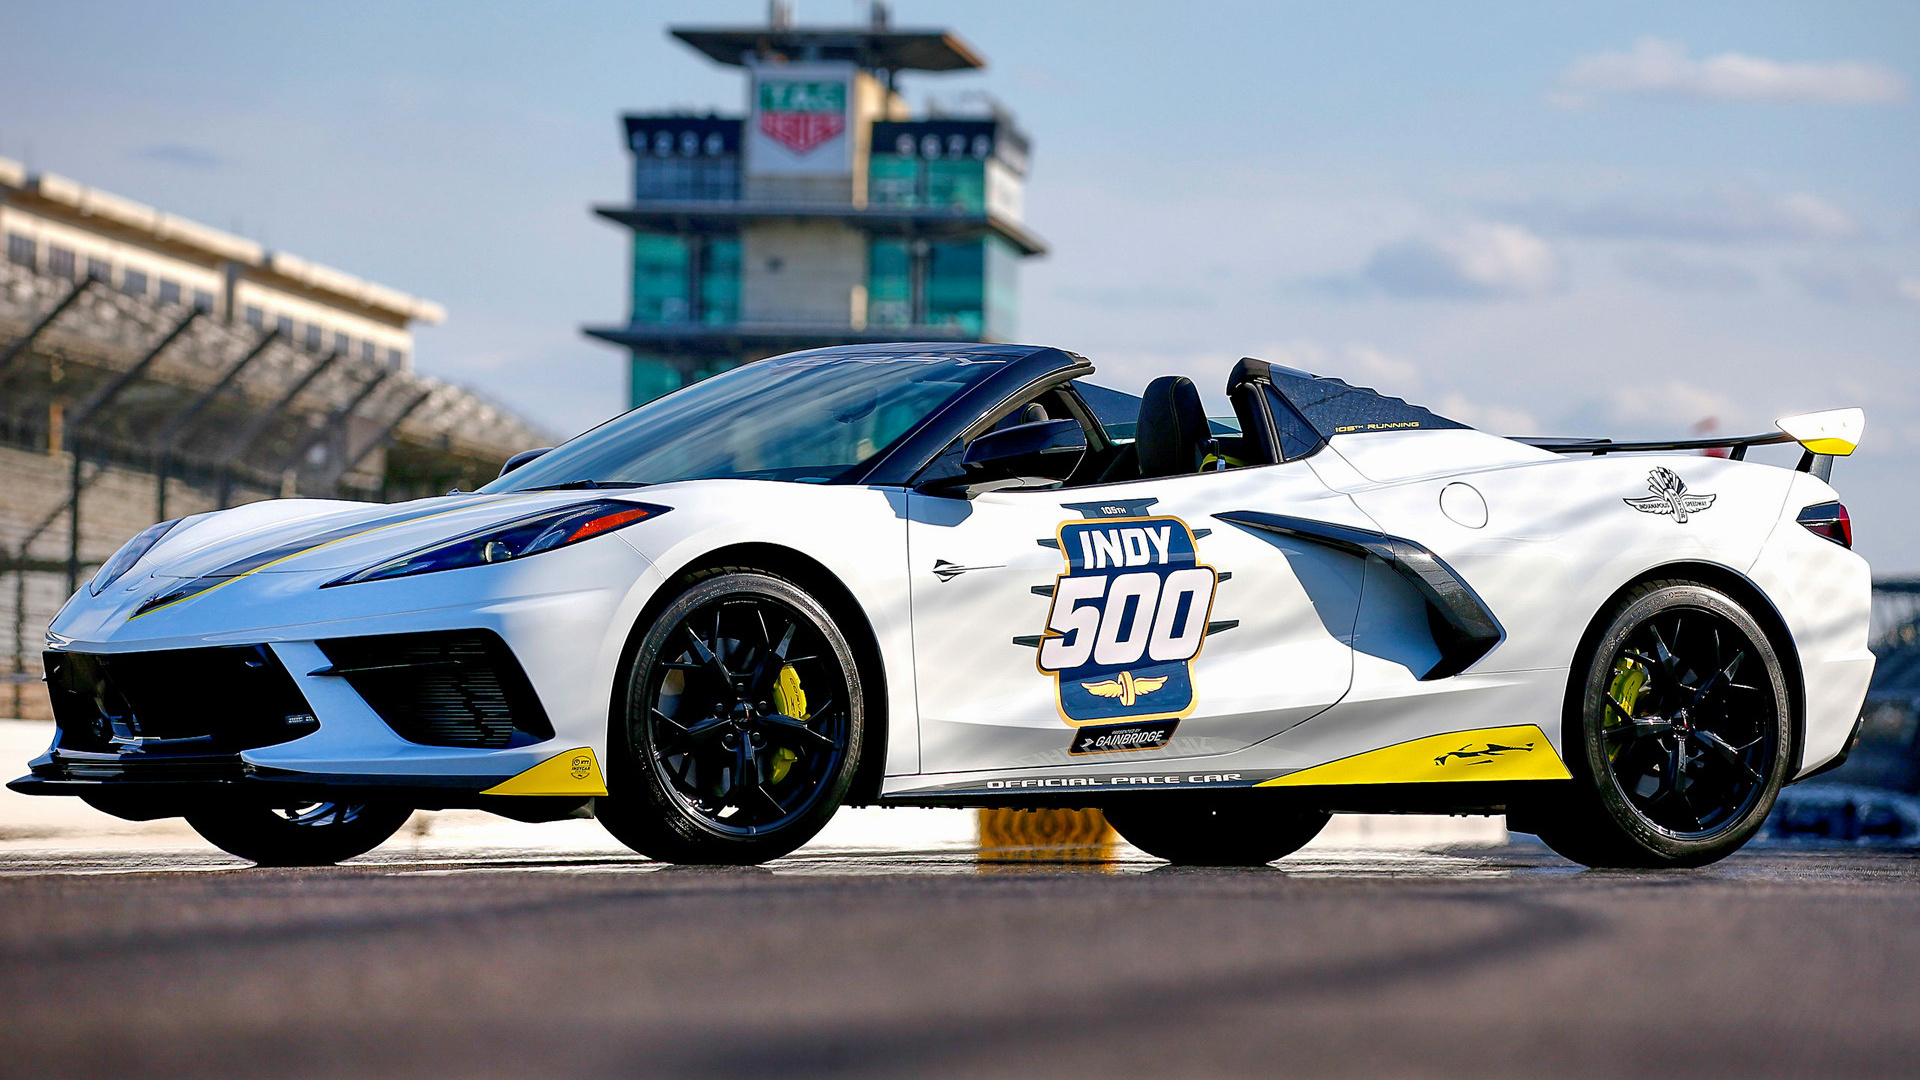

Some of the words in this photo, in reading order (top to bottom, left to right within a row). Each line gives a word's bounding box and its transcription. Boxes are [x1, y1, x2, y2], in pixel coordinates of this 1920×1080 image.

[763, 84, 838, 109] TAG
[1367, 421, 1420, 430] RUNNING
[1100, 505, 1127, 515] 105TH
[1639, 502, 1670, 510] INDIANAPOLIS
[1078, 526, 1171, 569] INDY
[1040, 568, 1215, 670] 500
[1095, 730, 1165, 747] GAINBRIDGE
[986, 777, 1103, 789] OFFICIAL
[1110, 775, 1180, 785] PACE
[1188, 773, 1242, 783] CAR
